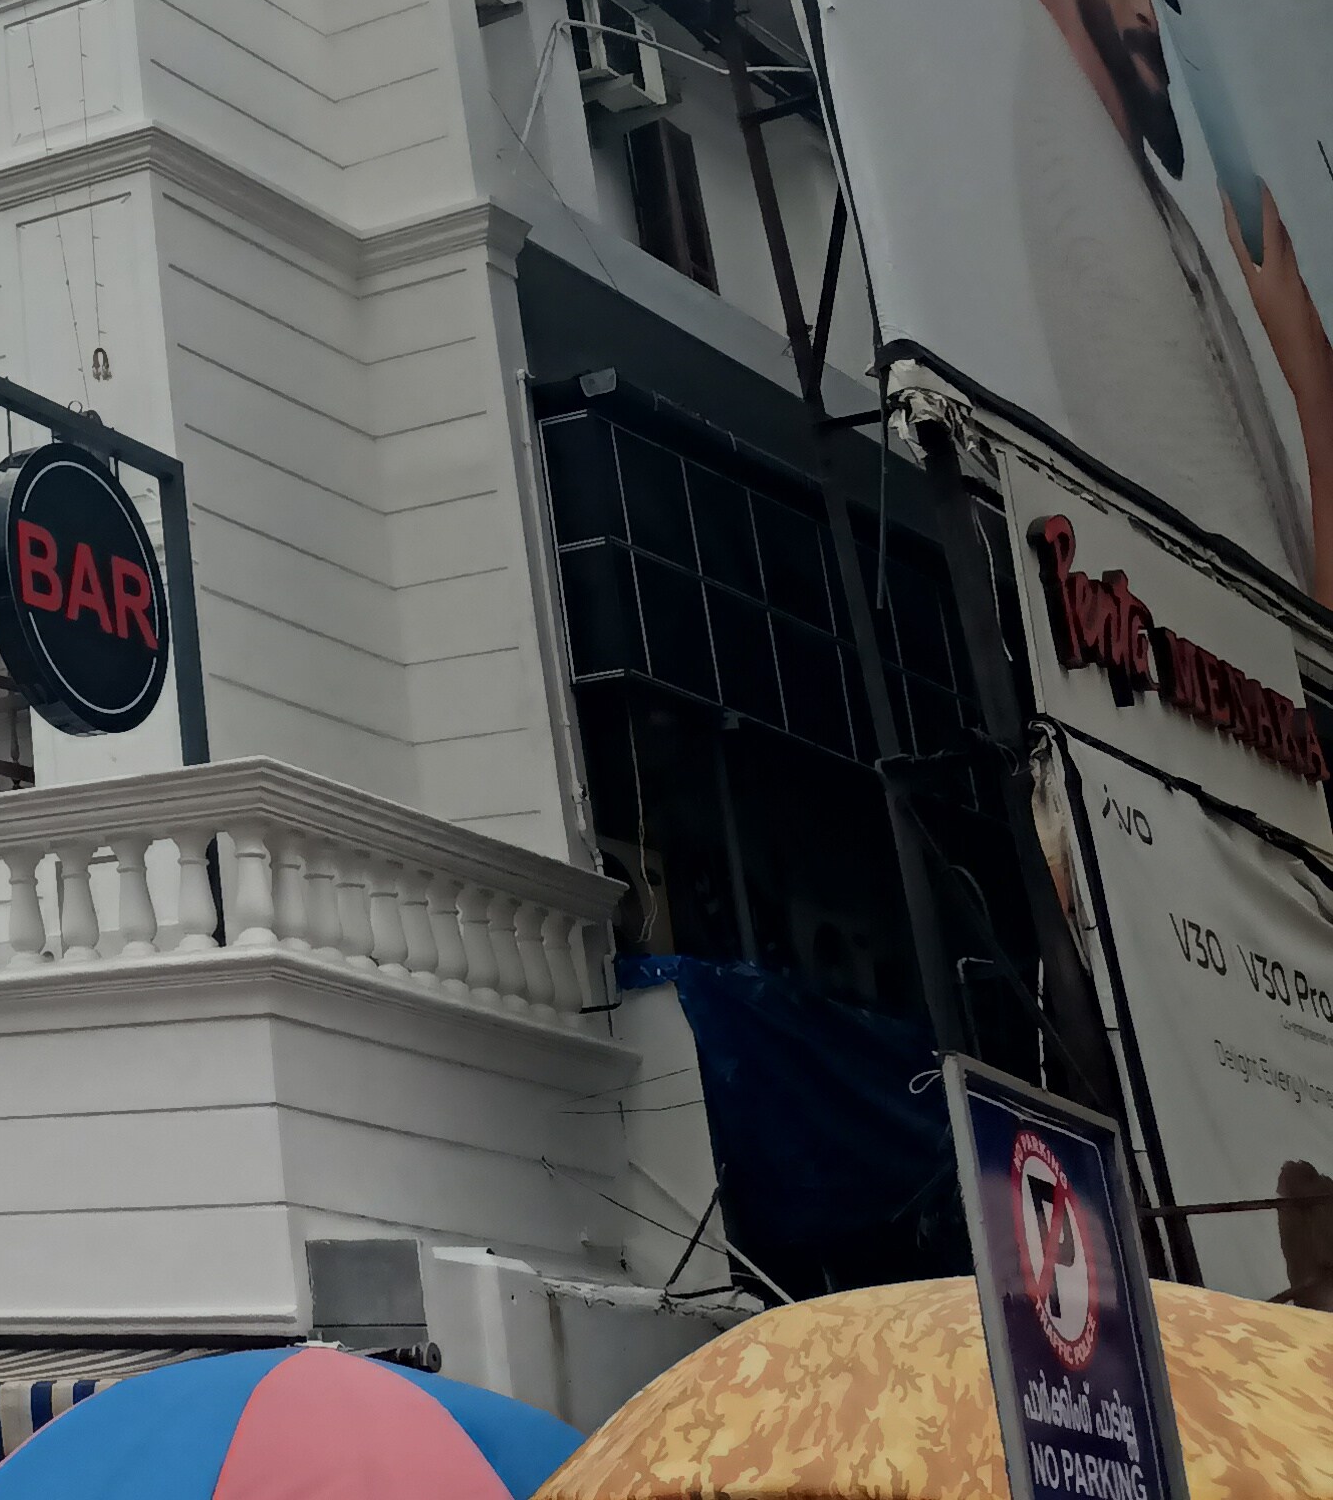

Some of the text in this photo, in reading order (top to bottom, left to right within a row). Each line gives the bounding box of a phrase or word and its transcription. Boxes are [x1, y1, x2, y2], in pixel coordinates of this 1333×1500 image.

[16, 519, 158, 650] BAR
[1169, 912, 1333, 1024] V30 V30 Pro
[1030, 1440, 1148, 1500] NO PARKING
